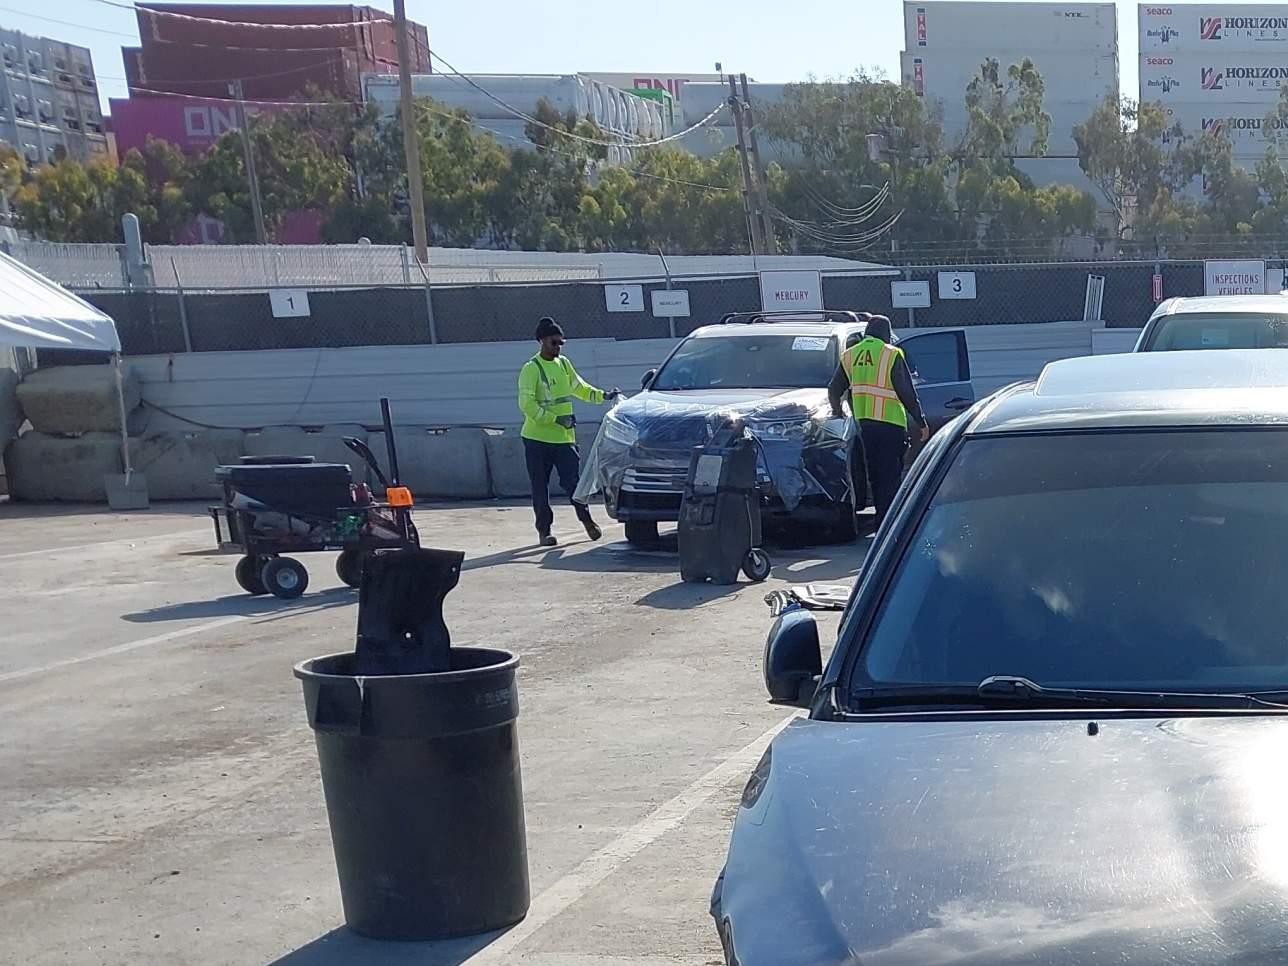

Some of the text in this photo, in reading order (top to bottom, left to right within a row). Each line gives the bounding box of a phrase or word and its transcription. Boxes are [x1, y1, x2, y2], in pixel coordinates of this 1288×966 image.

[1146, 7, 1173, 16] seaco
[1225, 17, 1288, 29] HORIZON
[1146, 57, 1174, 65] seaco
[1212, 274, 1260, 284] INSPECTIONS
[952, 278, 962, 292] 3
[775, 291, 810, 301] MERCURY
[1218, 286, 1254, 296] VEHICLES
[286, 296, 295, 310] 1
[619, 291, 630, 305] 2
